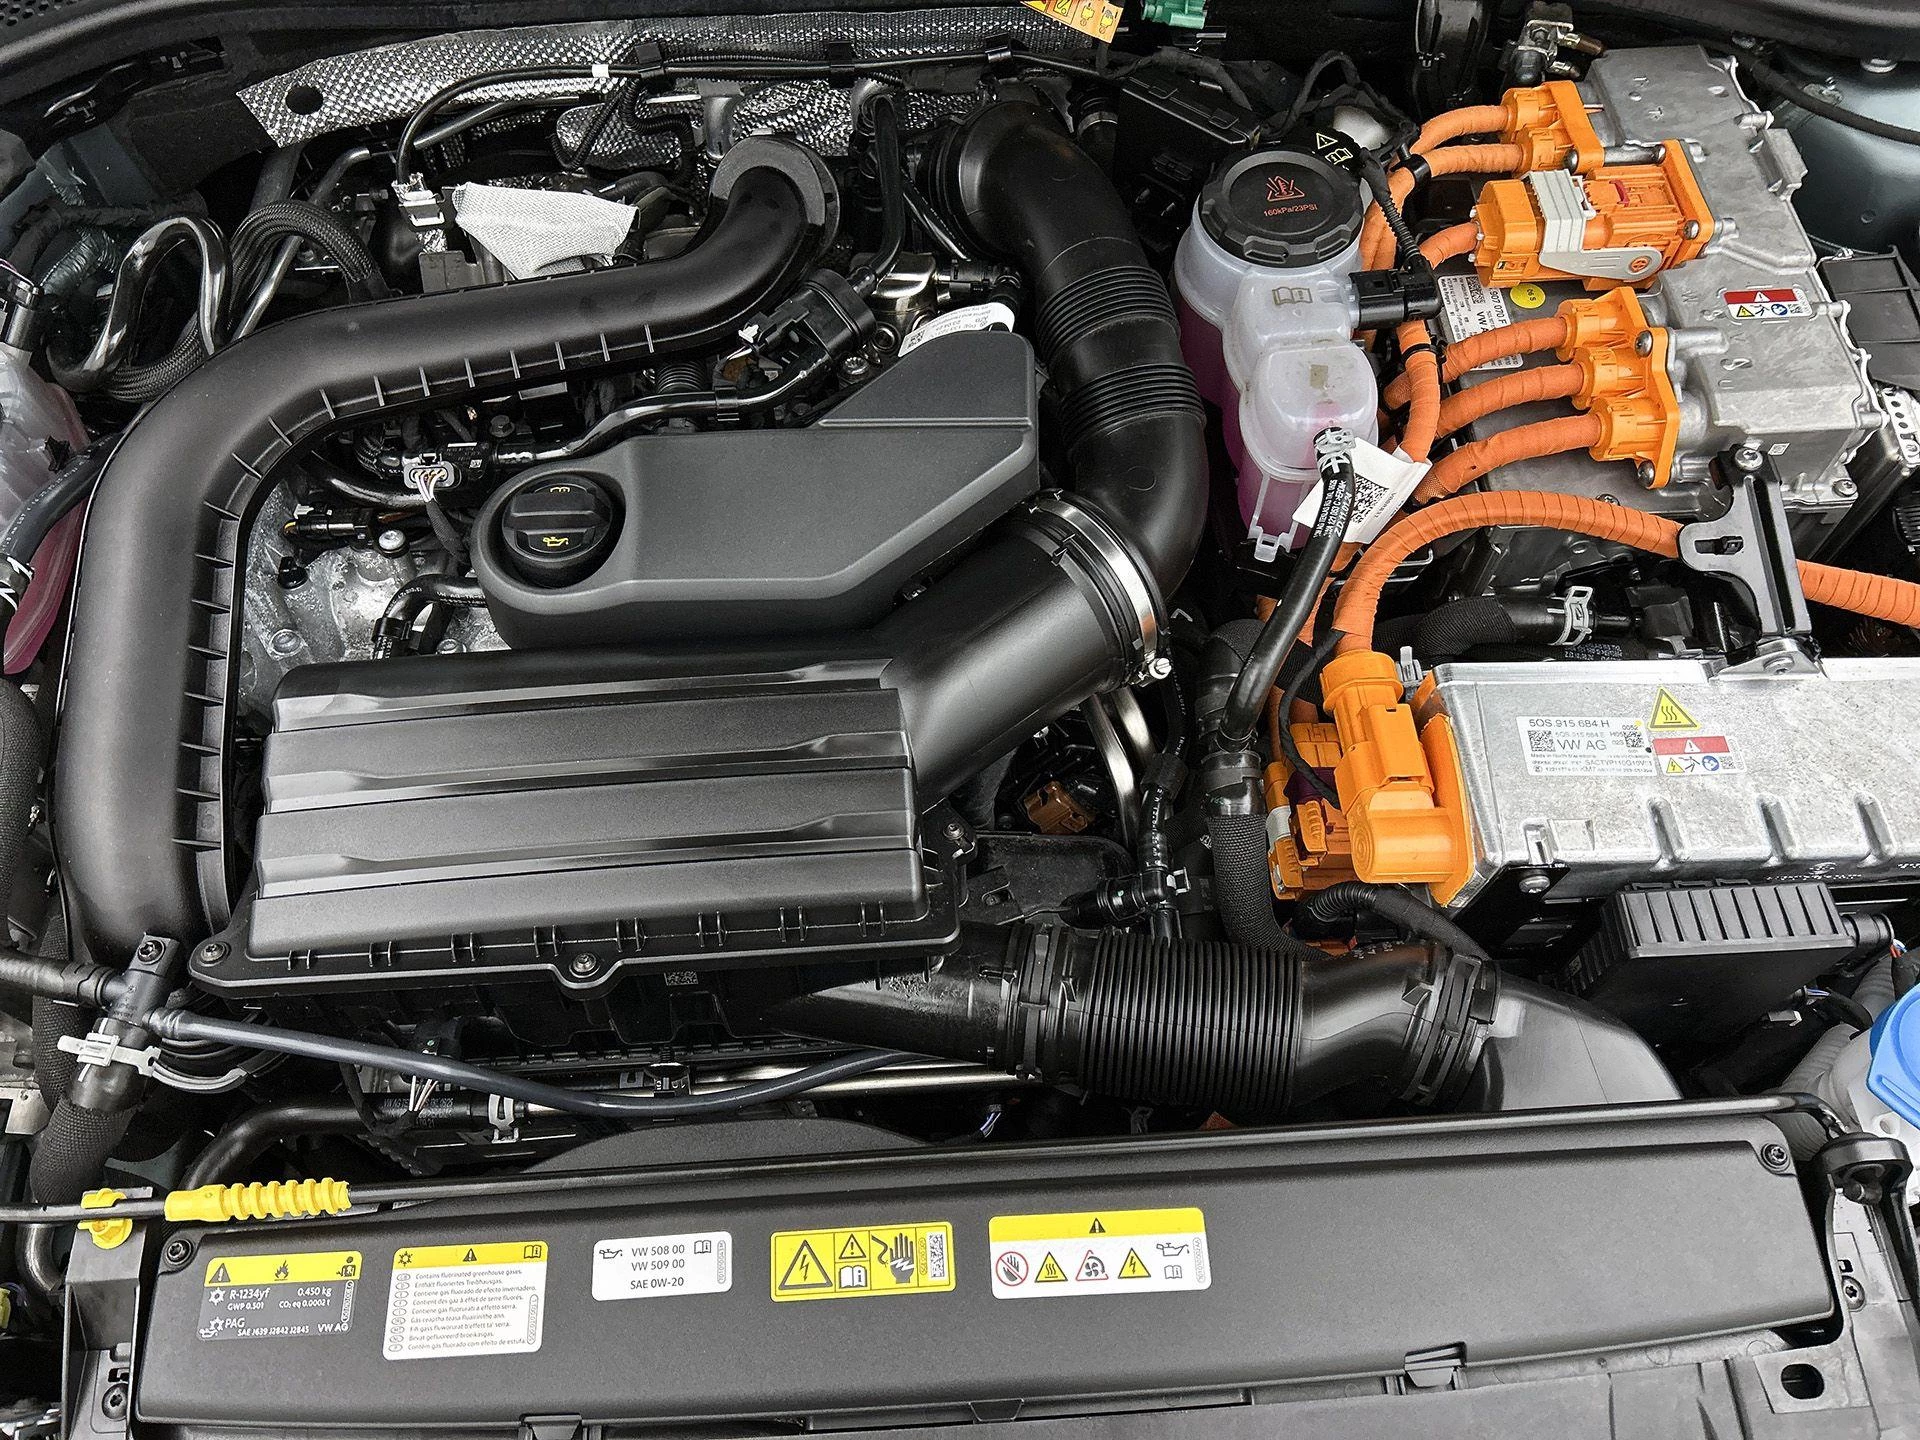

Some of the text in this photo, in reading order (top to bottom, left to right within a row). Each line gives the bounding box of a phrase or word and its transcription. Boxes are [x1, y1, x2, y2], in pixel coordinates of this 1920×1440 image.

[1263, 204, 1318, 217] 160kPa/23PSI
[1477, 311, 1488, 325] VW
[1556, 739, 1607, 751] VW AG
[631, 1244, 685, 1257] VW 508 00
[631, 1258, 685, 1272] VW 509 00
[416, 1272, 440, 1280] Contains
[630, 1276, 684, 1290] SAE 0W-20
[229, 1286, 333, 1301] R-1234yf 0.450 kg
[227, 1302, 245, 1311] GWP
[245, 1301, 265, 1310] 0.501
[301, 1298, 326, 1307] 0.0002
[224, 1317, 246, 1329] PAG
[317, 1322, 349, 1333] VW AG
[237, 1328, 251, 1337] SAE
